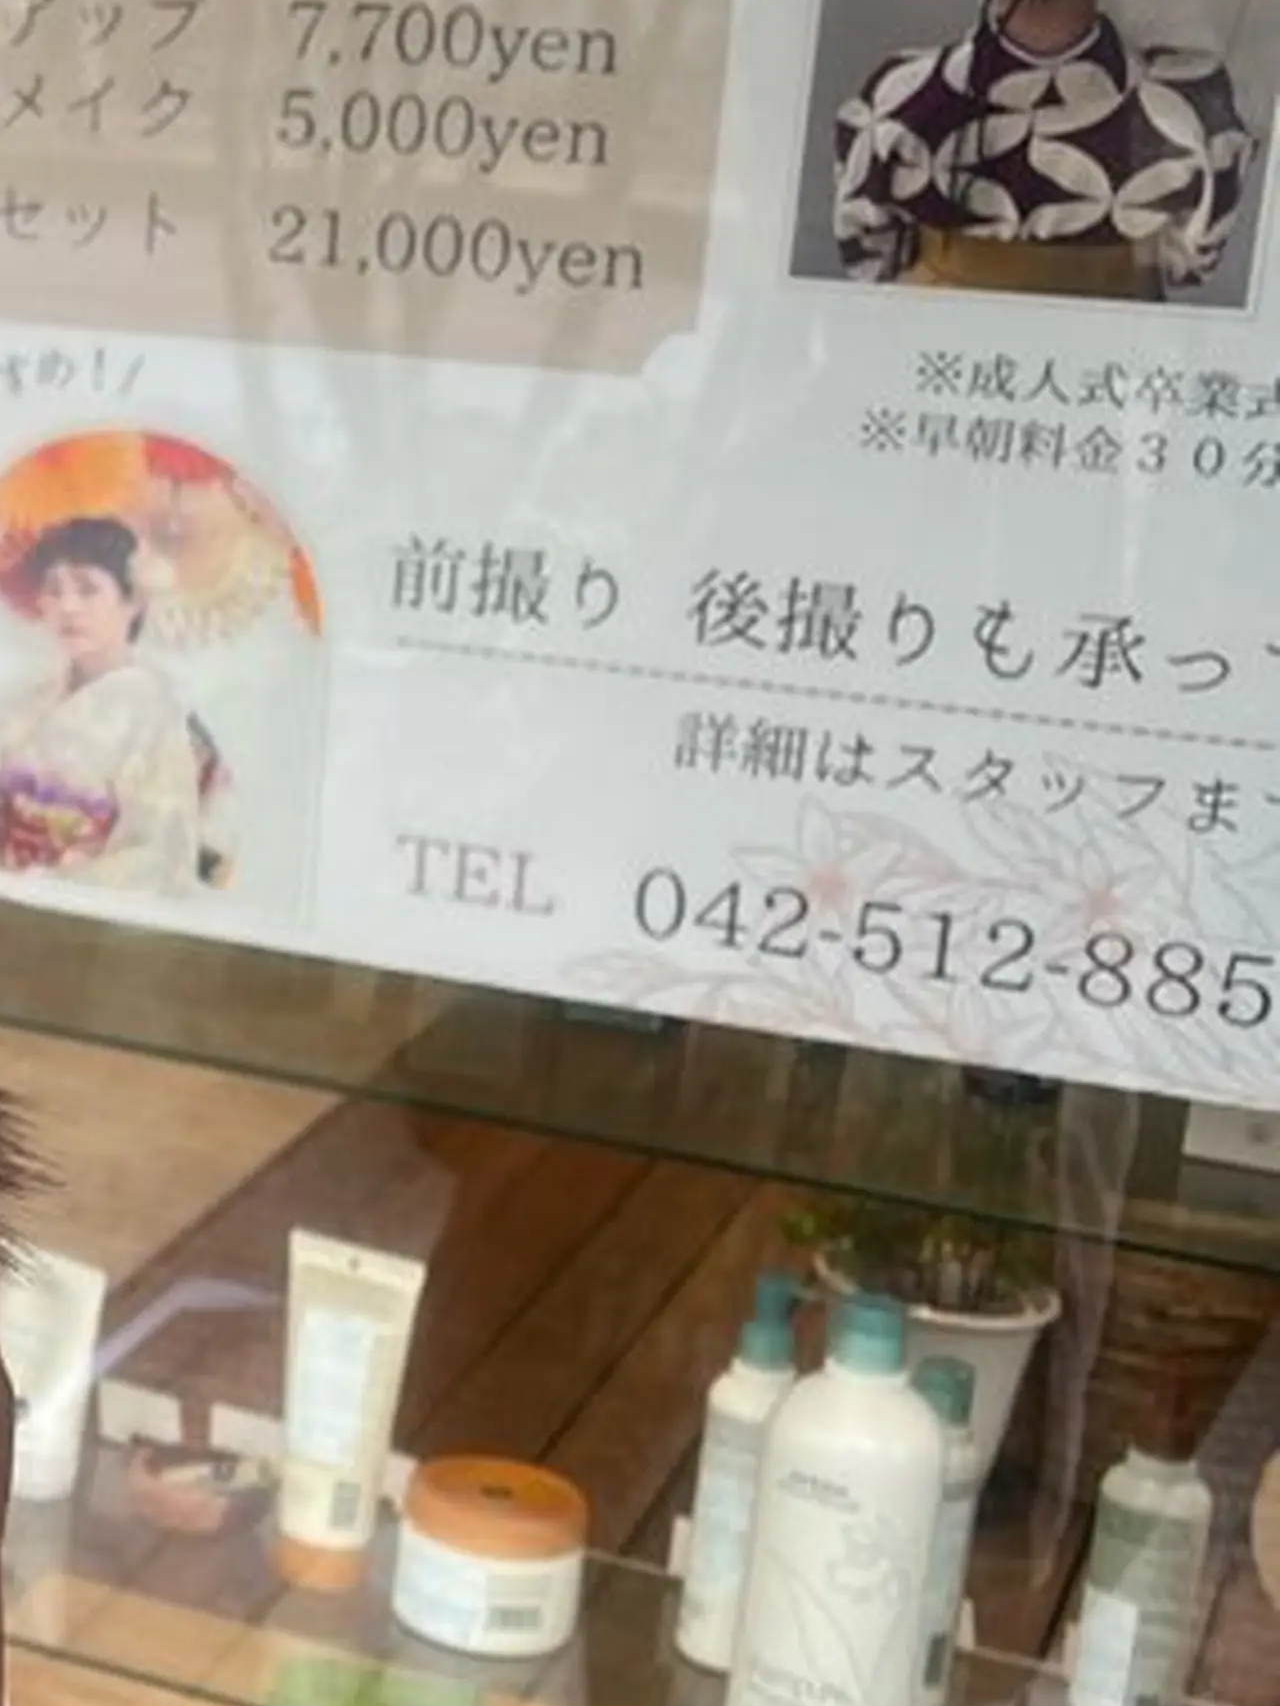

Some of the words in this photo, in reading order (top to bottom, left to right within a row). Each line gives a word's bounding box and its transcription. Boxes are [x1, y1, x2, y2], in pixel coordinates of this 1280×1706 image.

[275, 89, 609, 175] 5,000yen
[267, 203, 644, 297] 21,000yen
[392, 533, 620, 631] 前撮り
[685, 566, 1280, 691] 後撮りも承っ
[673, 709, 1280, 834] 詳細はスタッフま
[396, 834, 555, 916] TEL
[633, 865, 1278, 1029] 042-512-885
